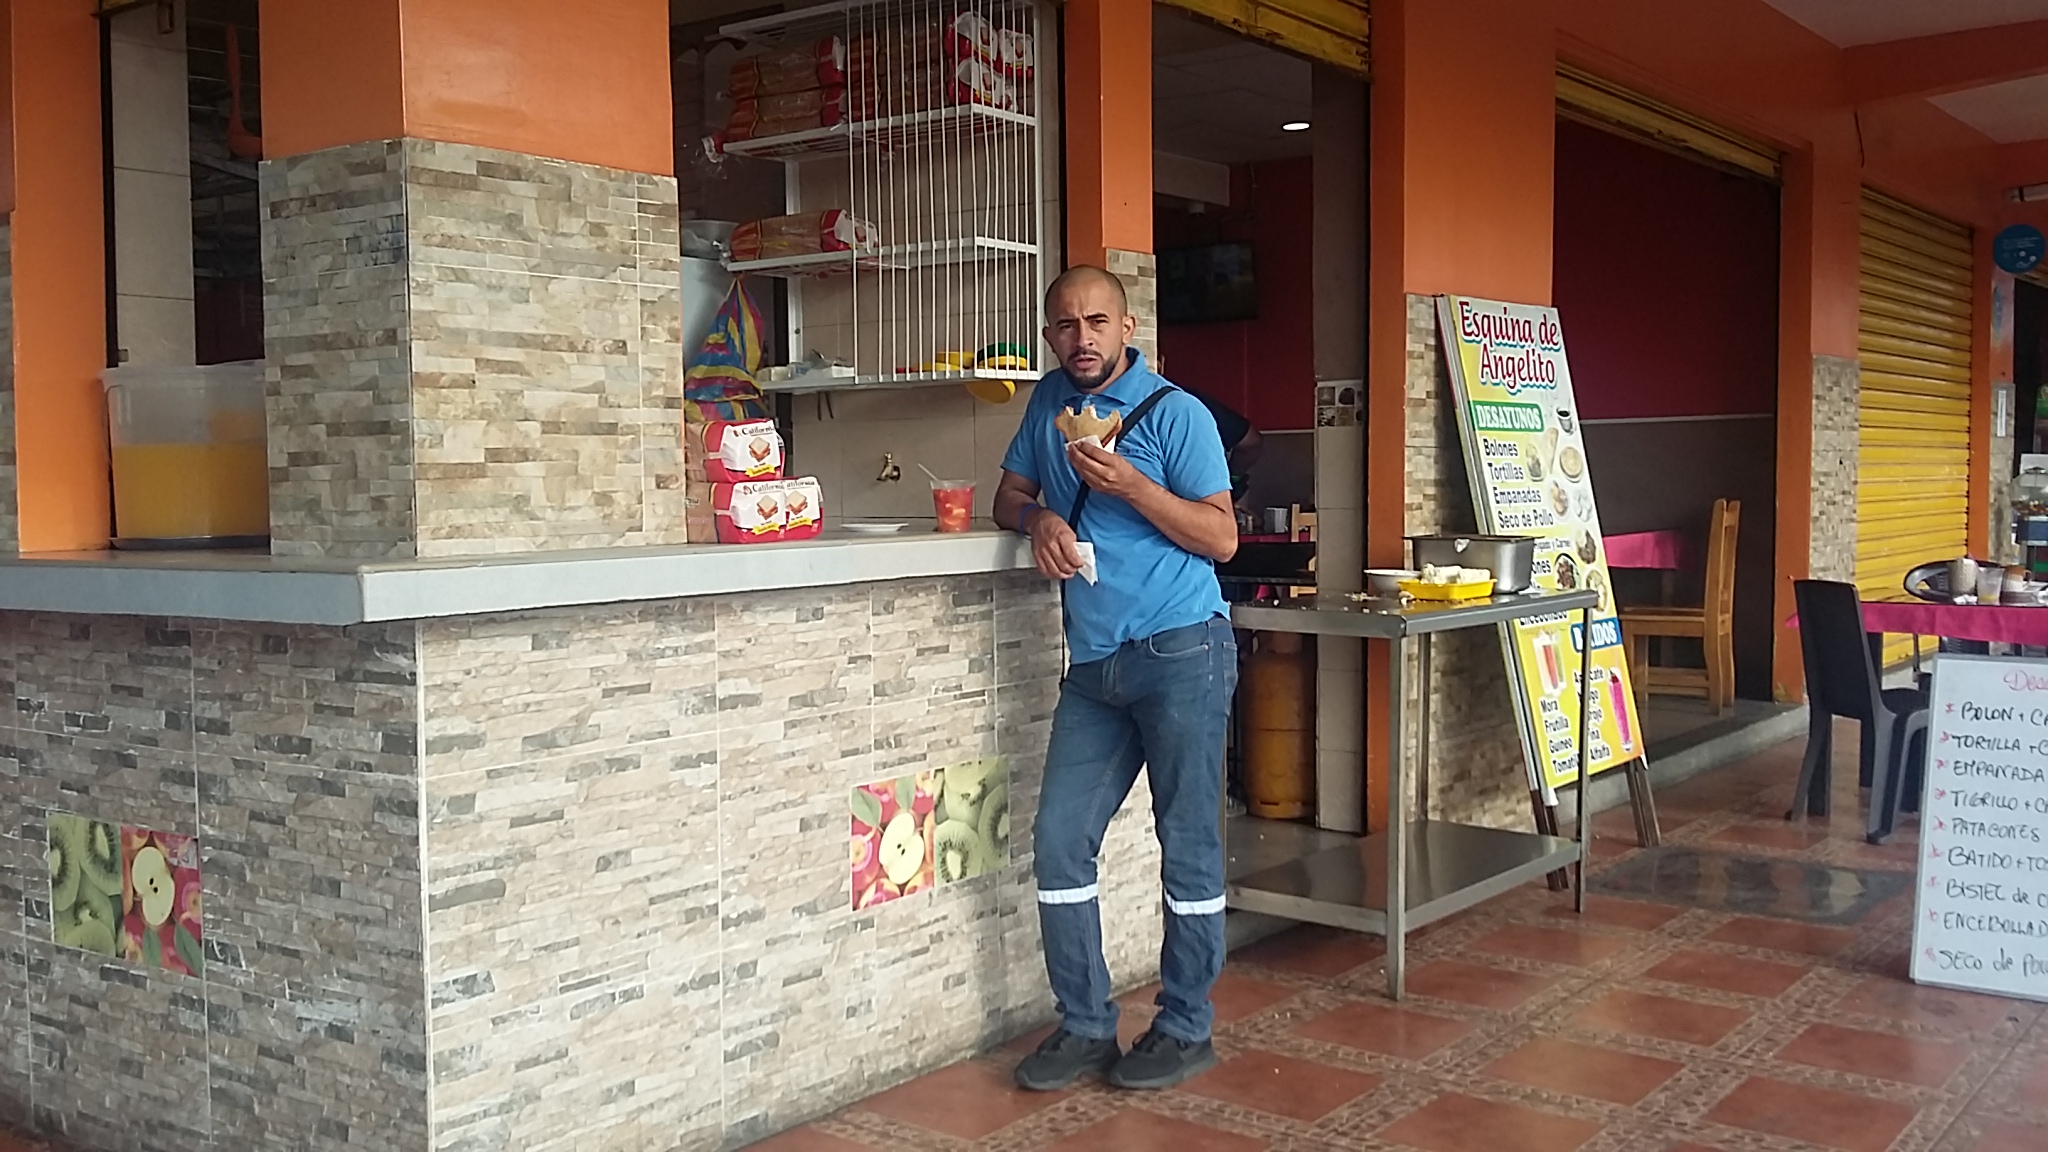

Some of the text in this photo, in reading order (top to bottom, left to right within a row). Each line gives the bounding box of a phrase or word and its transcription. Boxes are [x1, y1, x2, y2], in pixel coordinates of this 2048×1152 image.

[1459, 301, 1559, 347] Esquina de
[1480, 343, 1556, 389] Angelito
[1475, 405, 1541, 430] DESAYUNOS
[1483, 438, 1519, 457] Bolones
[1487, 462, 1524, 481] Tortillas
[782, 480, 815, 489] alifornia
[1493, 486, 1541, 507] Empanadas
[1498, 509, 1554, 529] Seco de Pollo
[1540, 700, 1558, 713] Mora
[1961, 701, 2014, 721] BOLON
[1544, 716, 1569, 733] Frutilla
[1951, 734, 2021, 751] TORTILLA
[1953, 759, 2045, 783] EMPANADA
[1950, 790, 2018, 811] TIGRILLO
[1948, 846, 2012, 869] BATIDO
[1947, 878, 2006, 901] BISTEC
[2012, 887, 2030, 905] de
[1993, 947, 2013, 971] de
